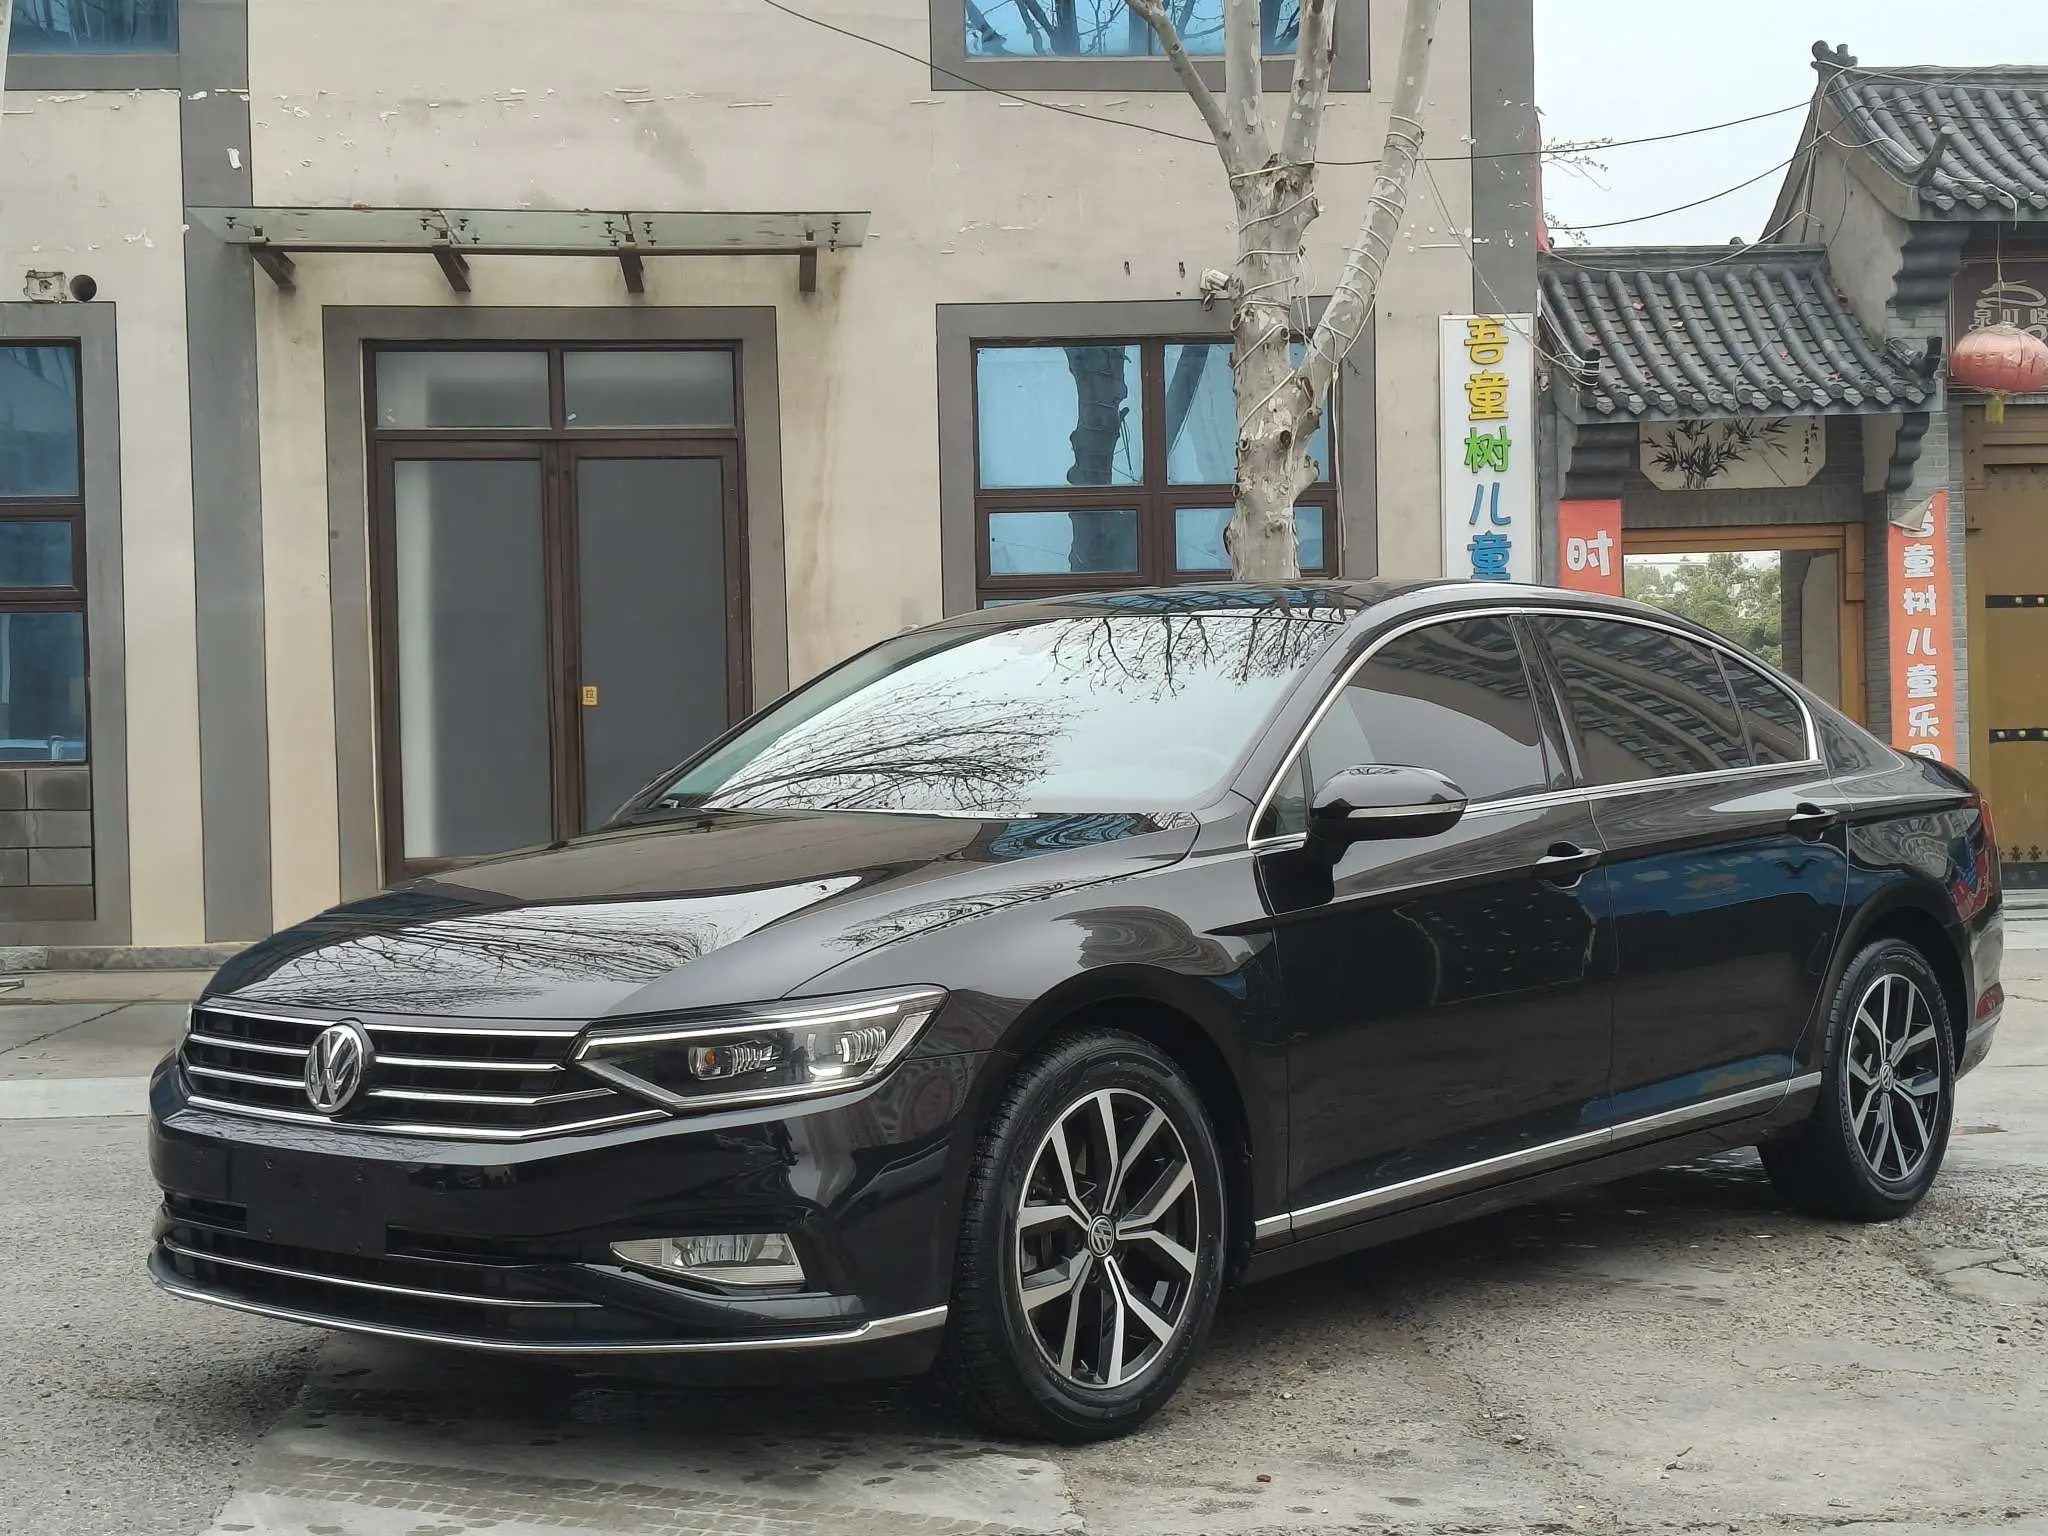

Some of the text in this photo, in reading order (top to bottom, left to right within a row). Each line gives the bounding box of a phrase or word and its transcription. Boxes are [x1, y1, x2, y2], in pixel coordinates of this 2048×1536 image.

[1464, 319, 1512, 580] 吾童树儿童
[1566, 530, 1614, 577] 时
